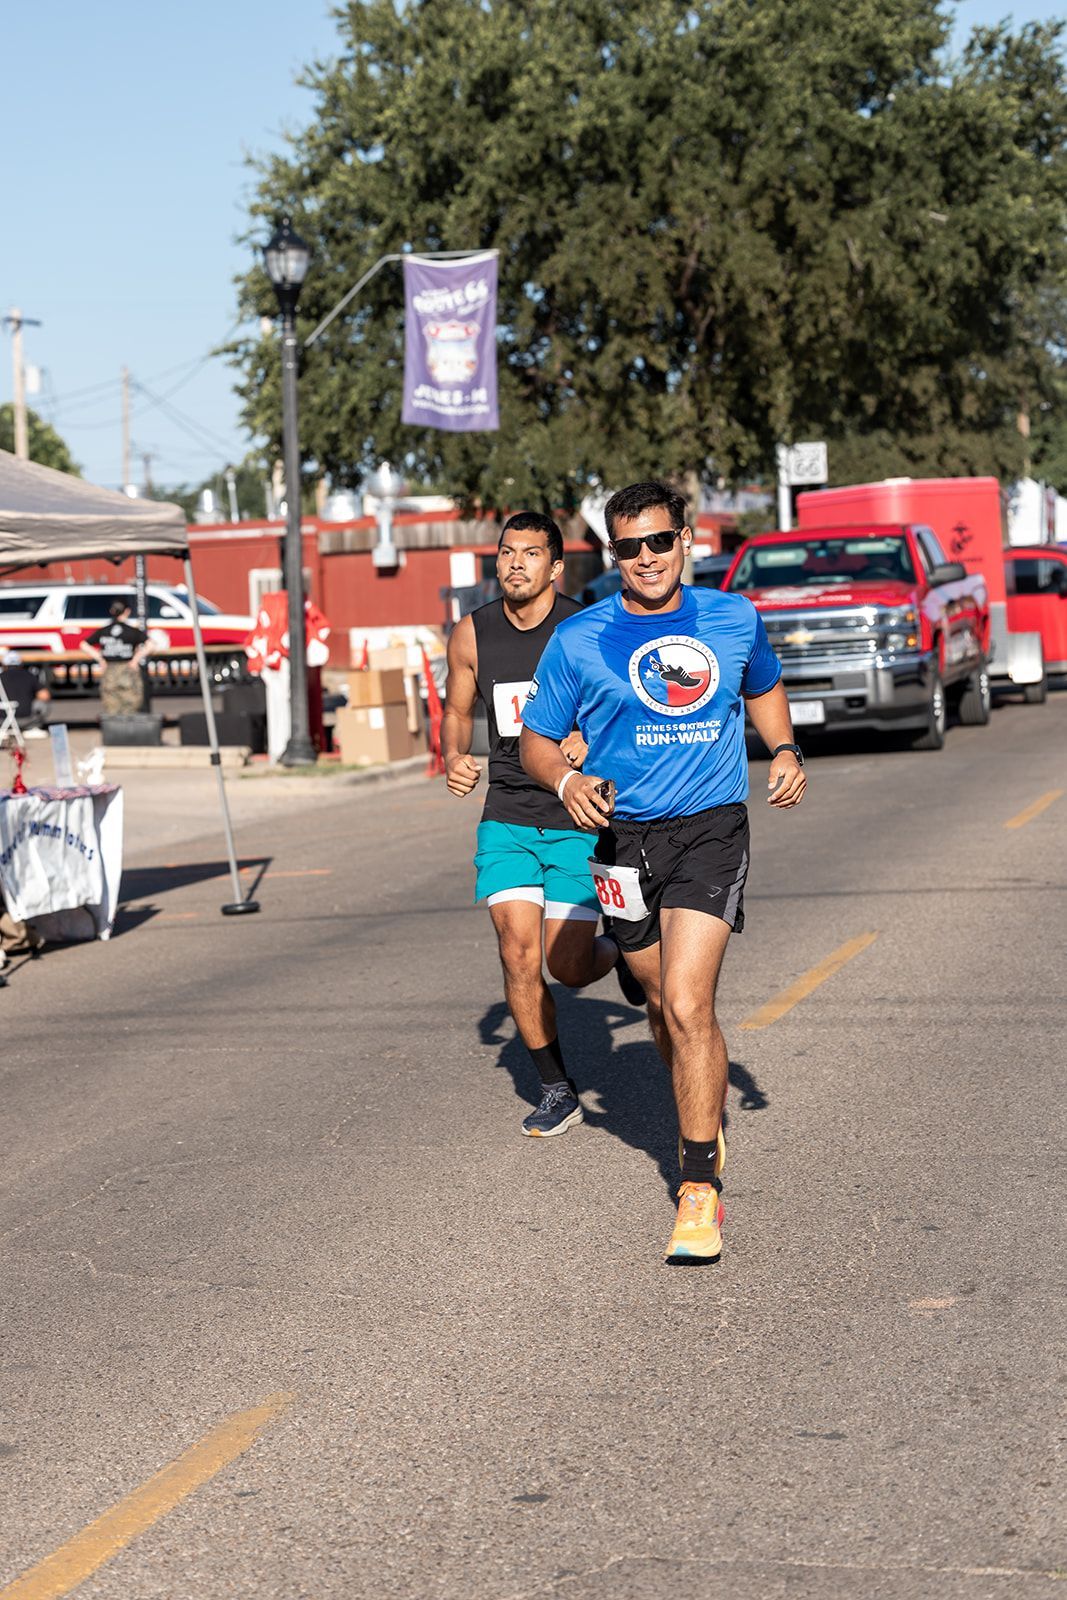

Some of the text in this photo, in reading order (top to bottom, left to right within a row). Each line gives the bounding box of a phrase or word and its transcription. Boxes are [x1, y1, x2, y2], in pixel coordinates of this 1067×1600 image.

[645, 692, 711, 714] SECOND ANNUAL
[636, 728, 720, 746] RUN+WALK
[593, 874, 625, 909] 88
